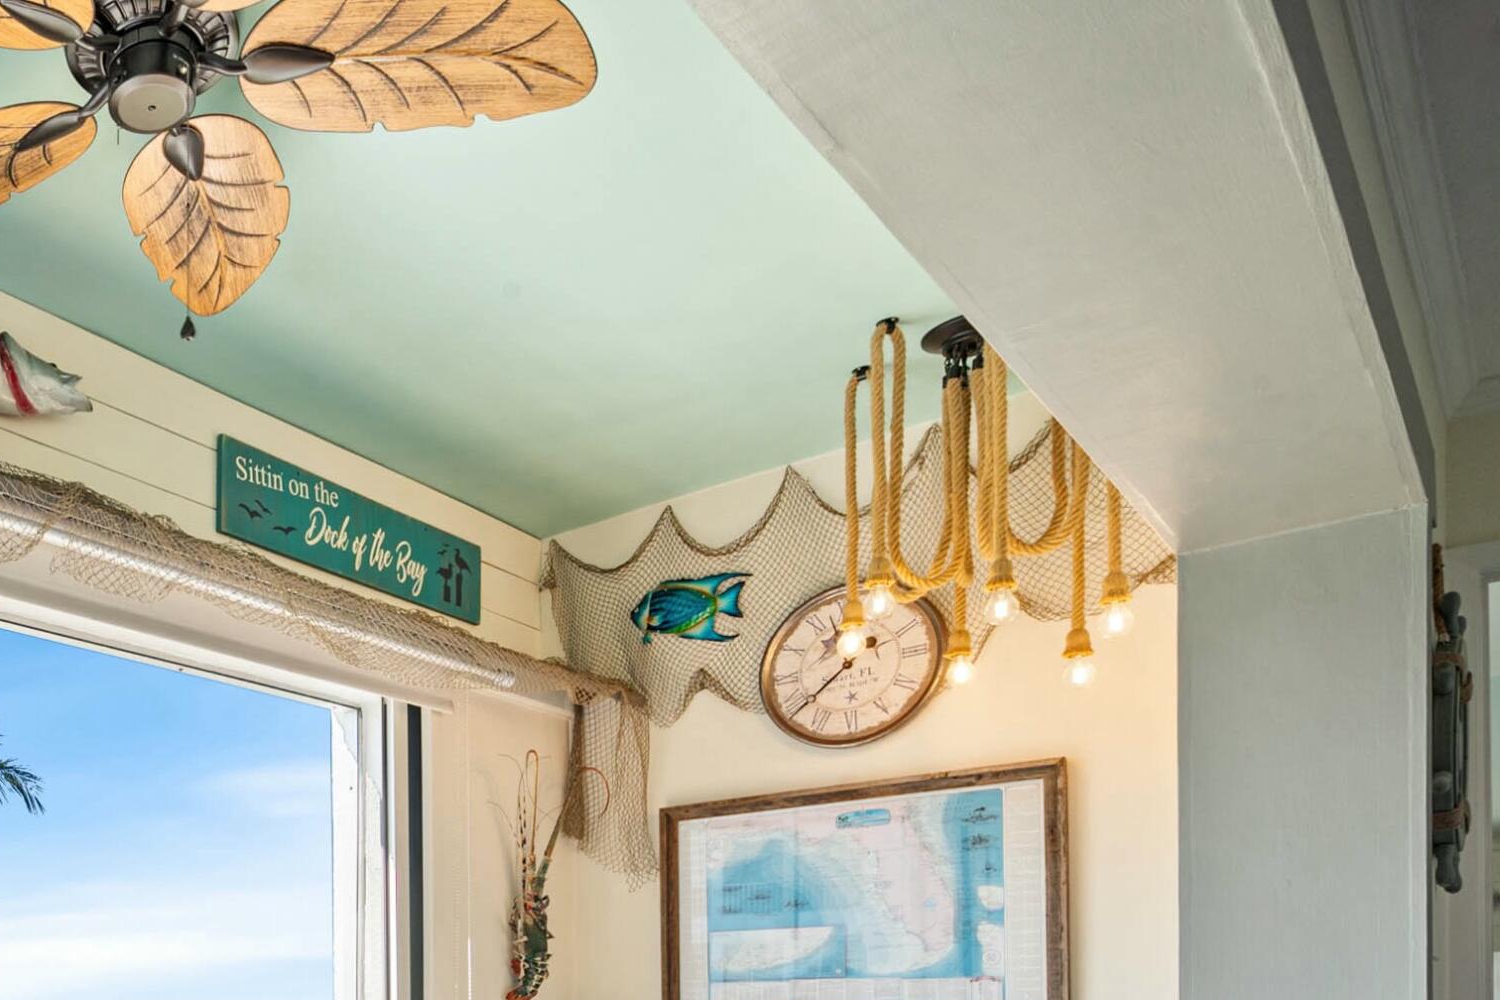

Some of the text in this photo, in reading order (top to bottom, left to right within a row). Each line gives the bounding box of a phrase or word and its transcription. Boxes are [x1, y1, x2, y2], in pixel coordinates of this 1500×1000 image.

[288, 477, 310, 500] on
[314, 481, 340, 508] the
[304, 507, 428, 597] Dock of the Bay
